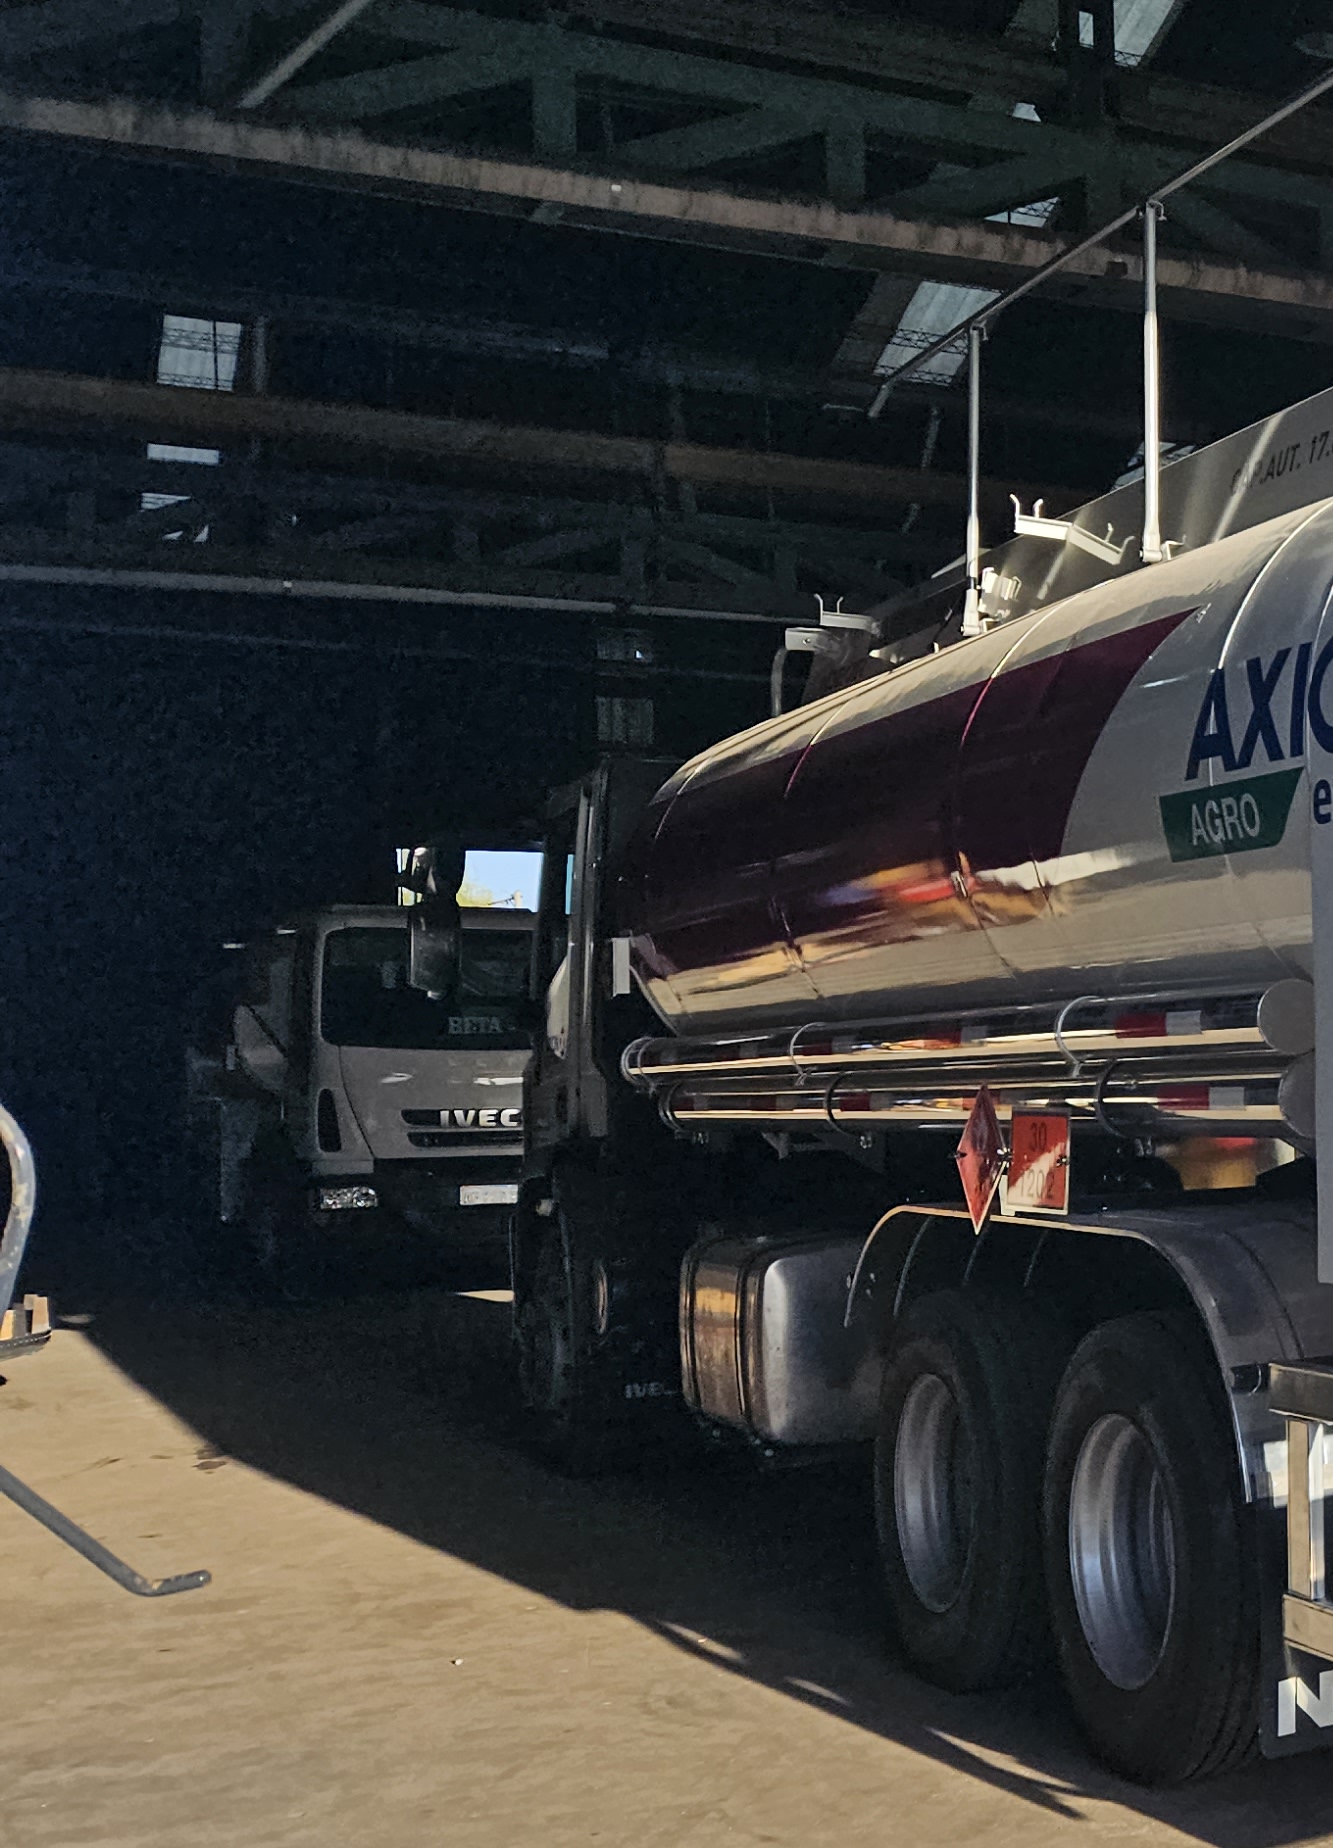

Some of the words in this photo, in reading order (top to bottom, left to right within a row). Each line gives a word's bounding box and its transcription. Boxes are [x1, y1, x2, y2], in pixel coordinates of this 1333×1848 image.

[1191, 792, 1262, 846] AGRO
[439, 1108, 523, 1128] IVEC
[1029, 1121, 1048, 1153] 30
[1020, 1168, 1056, 1200] 1202
